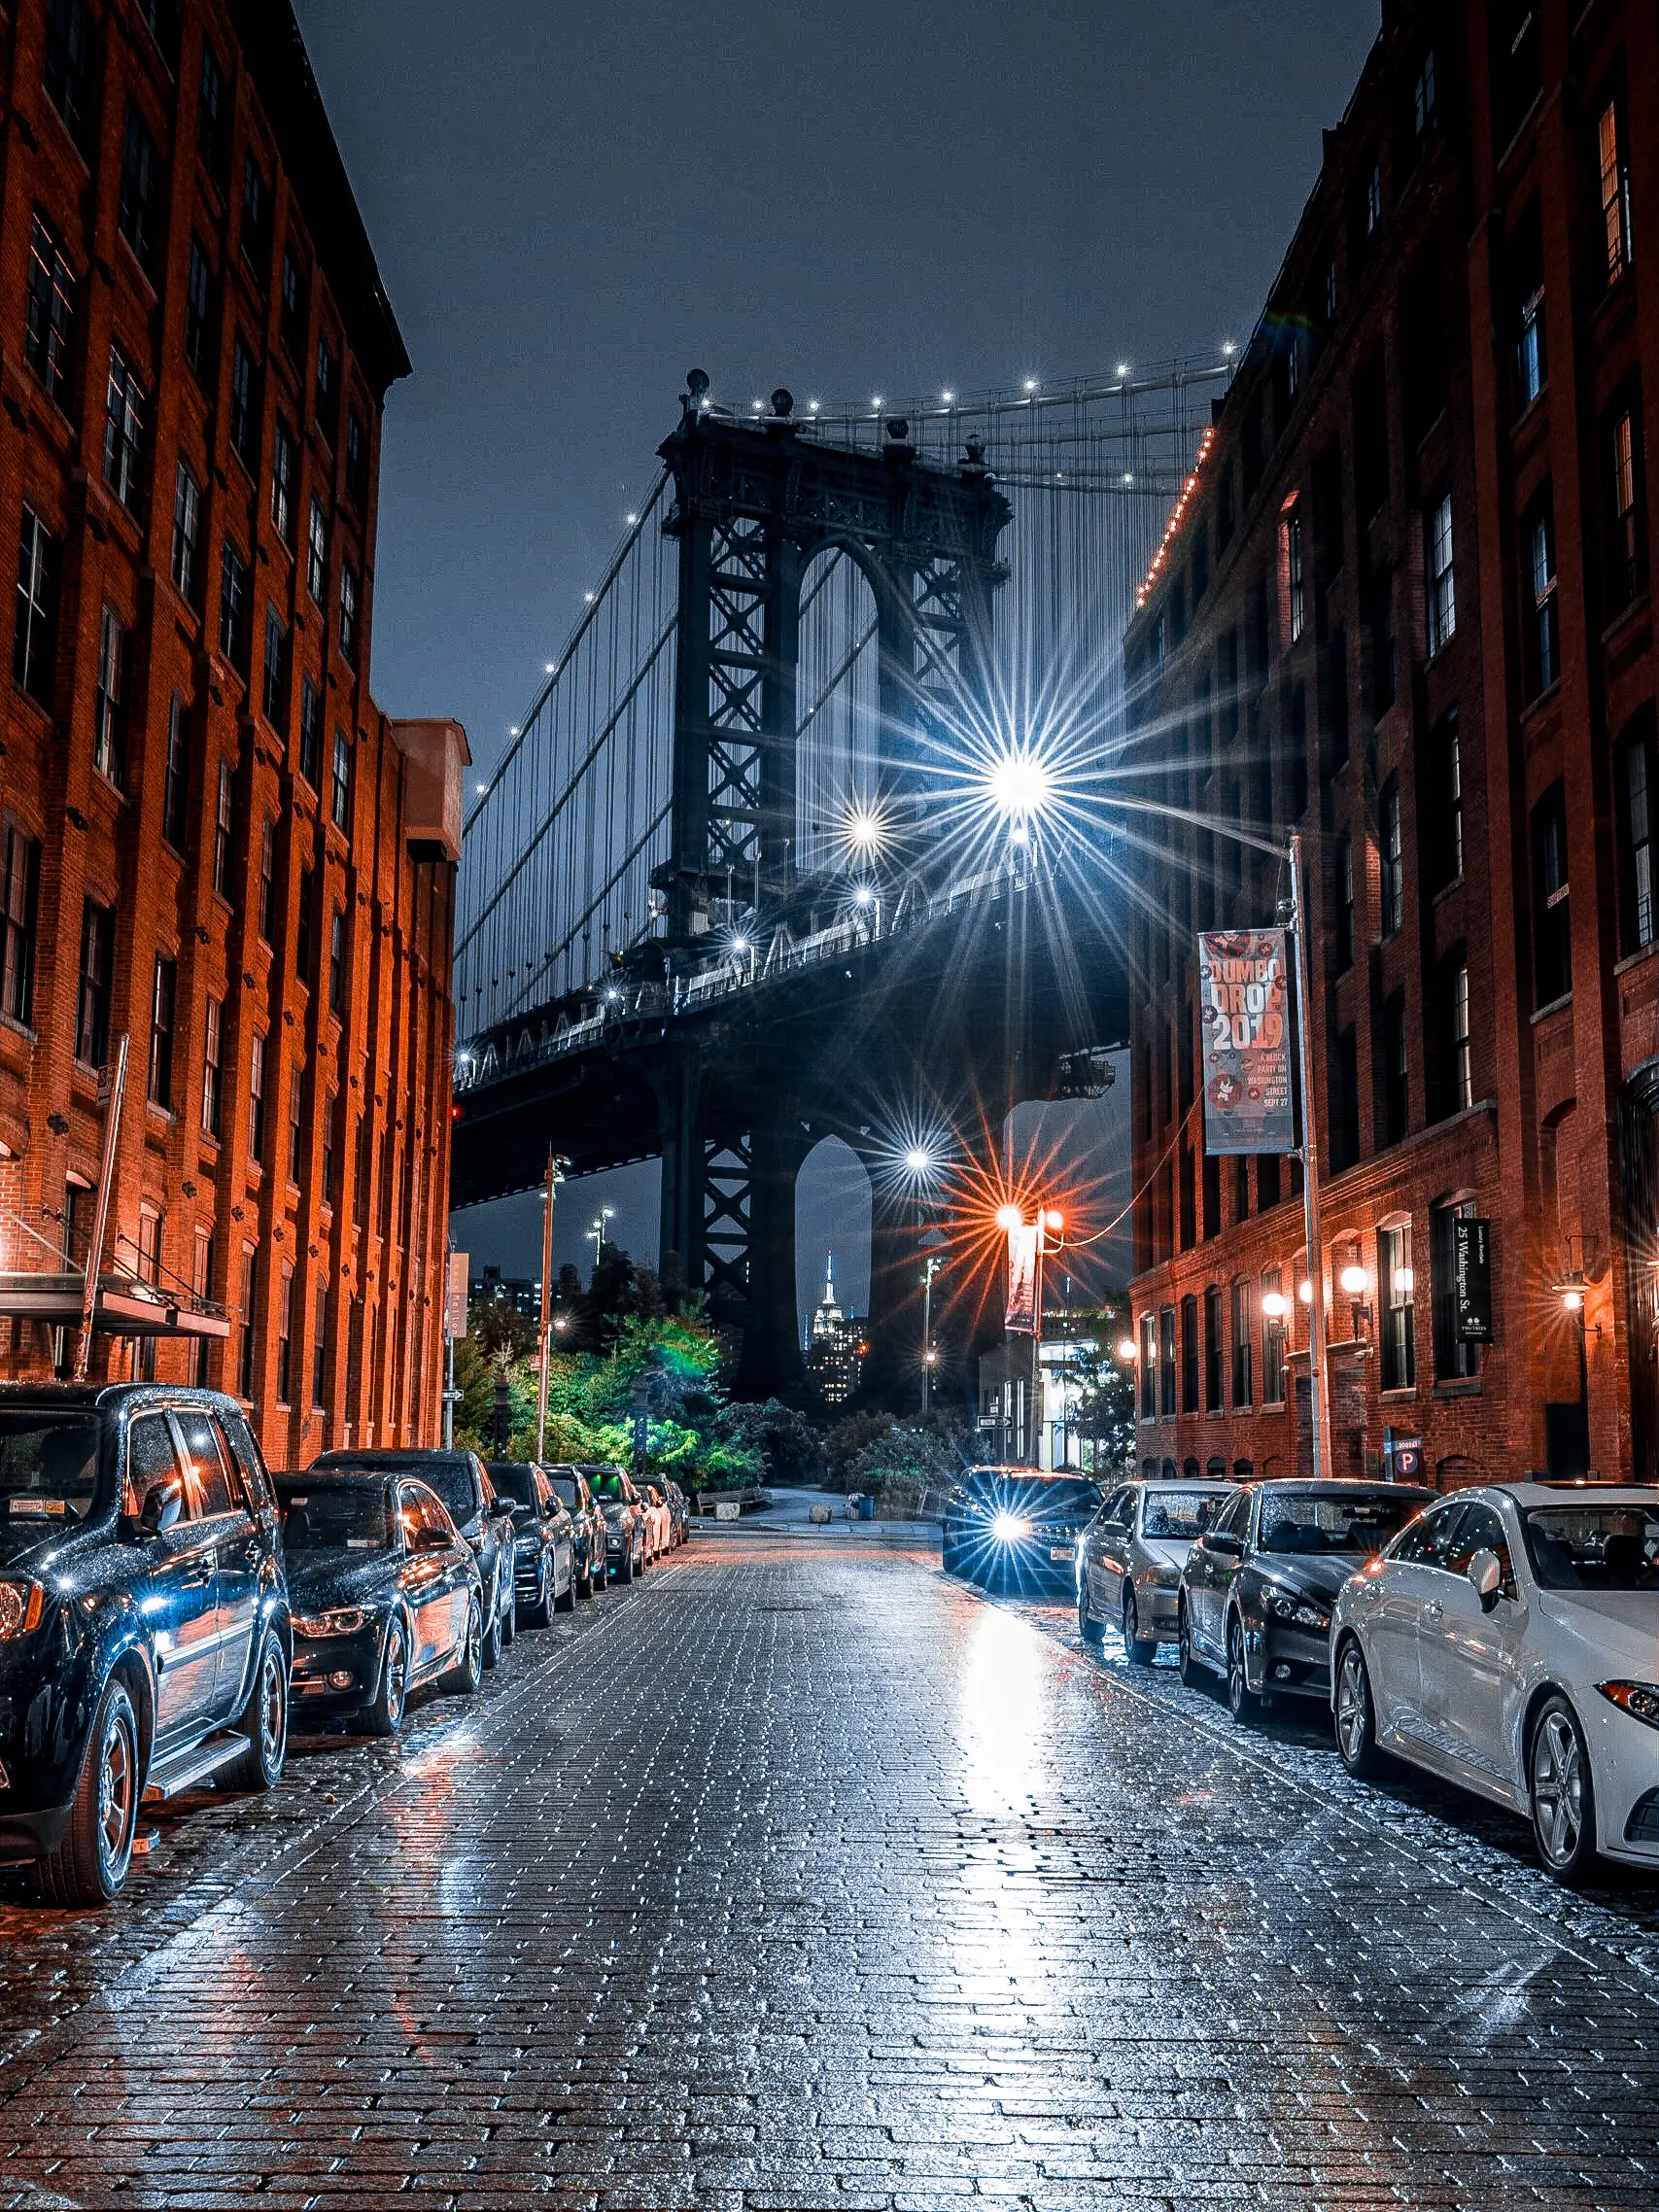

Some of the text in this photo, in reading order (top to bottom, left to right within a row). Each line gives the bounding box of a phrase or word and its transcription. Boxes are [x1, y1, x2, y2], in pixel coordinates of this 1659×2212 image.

[1208, 958, 1282, 983] DUMBO
[1210, 982, 1283, 1014] DROP
[1212, 1013, 1283, 1051] 2019
[1263, 1098, 1289, 1107] SEPT 27
[1265, 1088, 1288, 1096] STREET
[1456, 1226, 1470, 1313] 25 Washington St.
[1401, 1452, 1414, 1470] P
